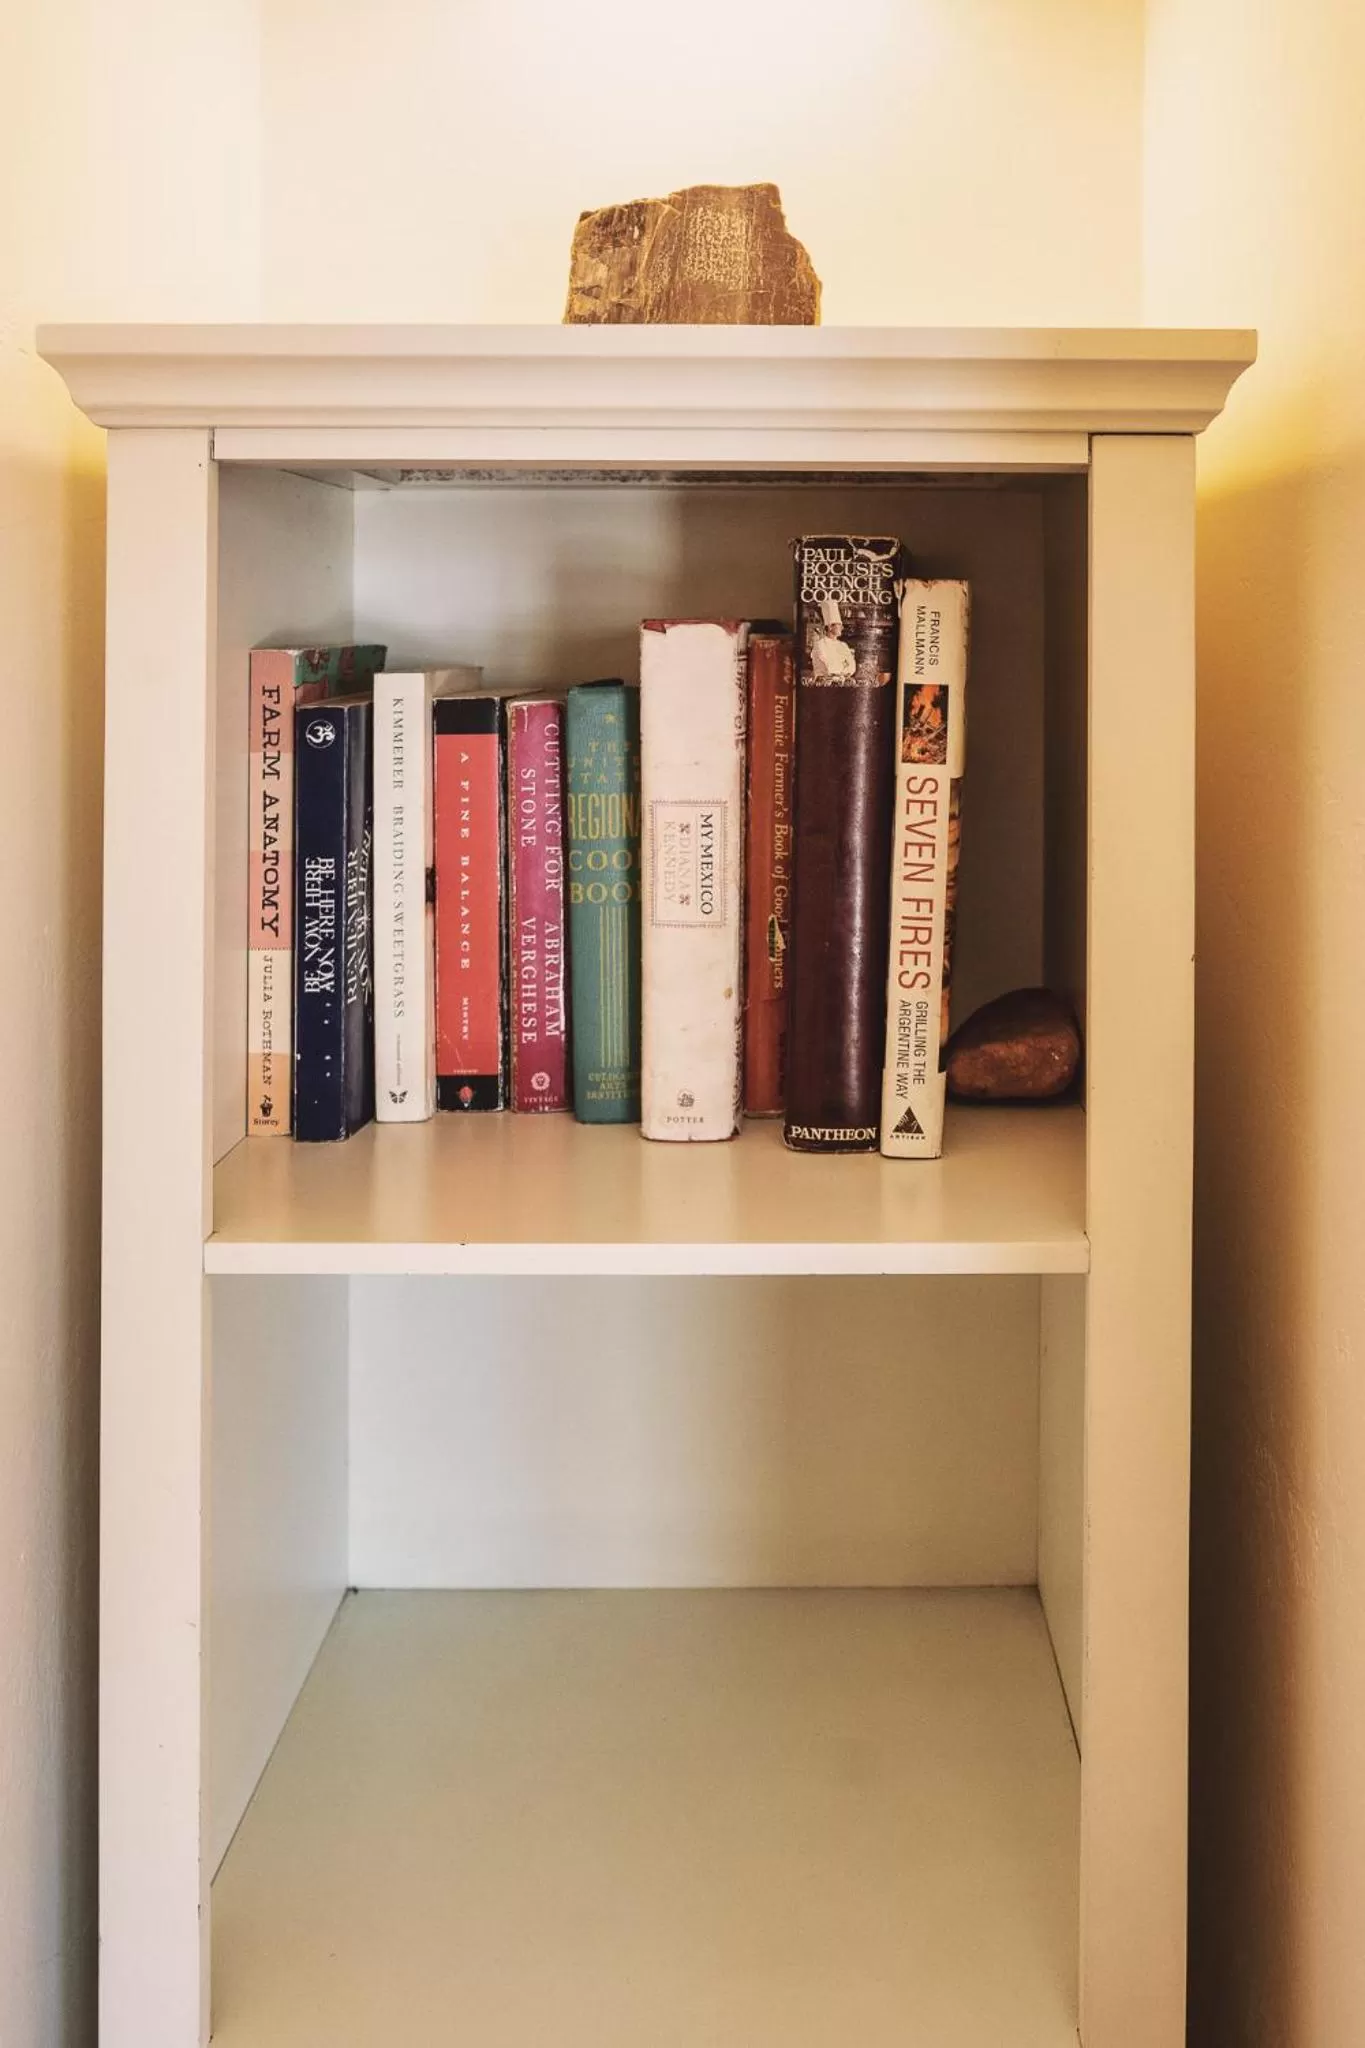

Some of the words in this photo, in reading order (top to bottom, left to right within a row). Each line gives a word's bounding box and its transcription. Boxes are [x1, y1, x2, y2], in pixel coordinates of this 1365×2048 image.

[802, 548, 850, 562] PAUL
[803, 562, 894, 577] BOCUSE'S
[801, 589, 893, 604] COOKING
[802, 575, 883, 590] FRENCH
[914, 605, 927, 676] MALLMANN
[928, 610, 941, 666] FRANCIS
[261, 685, 281, 780] FARM
[393, 697, 404, 790] KIMMERER
[774, 694, 788, 746] Fannie
[460, 752, 470, 764] A
[544, 723, 562, 836] CUTTING
[460, 780, 470, 839] FINE
[521, 767, 537, 848] STONE
[774, 752, 789, 819] Farmer's
[393, 805, 405, 894] BRAIDING
[700, 813, 714, 840] MY
[774, 823, 788, 860] Book
[903, 775, 939, 883] SEVEN
[261, 790, 281, 938] ANATOMY
[305, 857, 321, 907] HERE
[319, 857, 335, 880] BE
[545, 845, 562, 891] FOR
[569, 849, 641, 873] COO
[663, 821, 677, 901] KENNEDY
[679, 837, 692, 889] DIANA
[700, 844, 714, 915] MEXICO
[771, 863, 790, 879] of
[319, 889, 335, 940] HERE
[460, 855, 470, 970] BALANCE
[570, 881, 641, 905] BOO
[304, 915, 322, 962] NOW
[393, 900, 405, 1019] SWEETGRASS
[898, 897, 934, 989] FIRES
[261, 954, 274, 1002] JULIA
[305, 970, 320, 993] BE
[317, 947, 335, 993] NOW
[521, 916, 538, 1044] VERGHESE
[544, 921, 562, 1037] ABRAHAM
[261, 1010, 273, 1087] ROTHMAN
[896, 1000, 912, 1069] ARGENTINE
[912, 1001, 929, 1057] GRILLING
[895, 1072, 911, 1100] WAY
[912, 1061, 927, 1085] THE
[791, 1125, 878, 1141] PANTHEON
